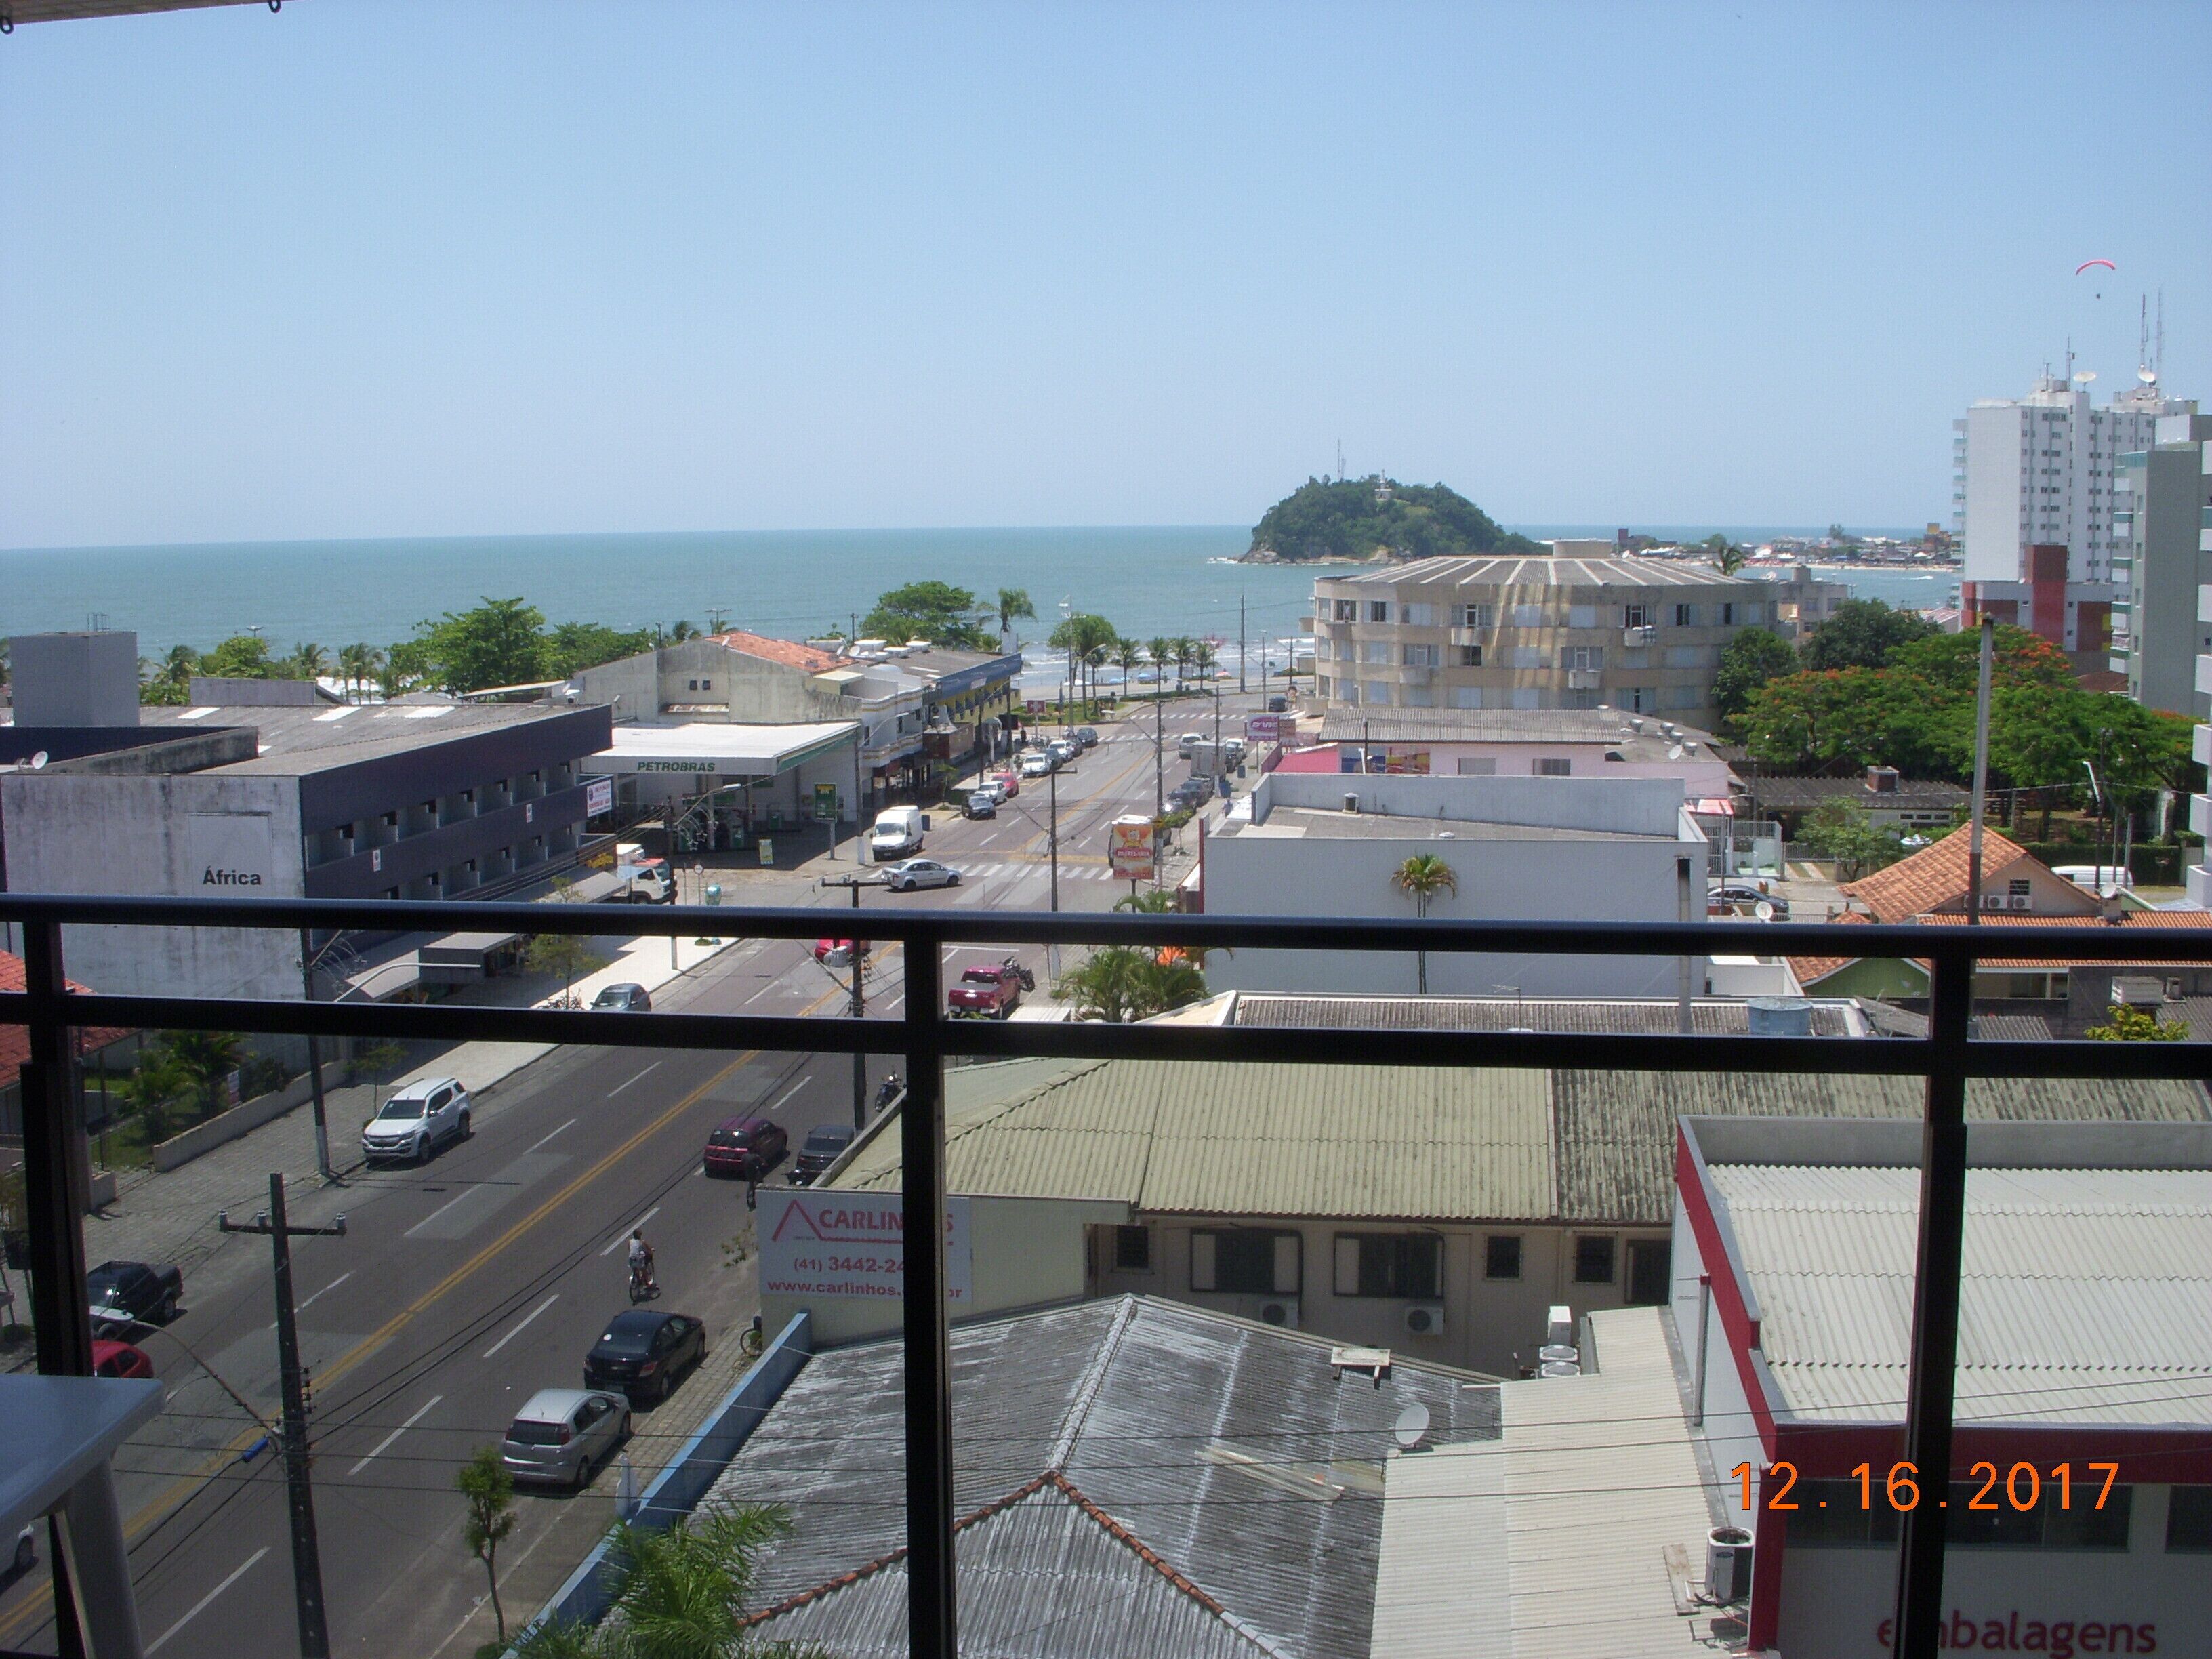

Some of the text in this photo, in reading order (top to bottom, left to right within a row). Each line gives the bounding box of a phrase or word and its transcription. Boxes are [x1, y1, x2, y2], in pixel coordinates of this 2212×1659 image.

[637, 762, 716, 772] PETROBRAS
[202, 865, 262, 885] África
[819, 1208, 954, 1232] CARLINS
[794, 1257, 822, 1273] (41)
[1876, 1610, 2157, 1659] ebalagens
